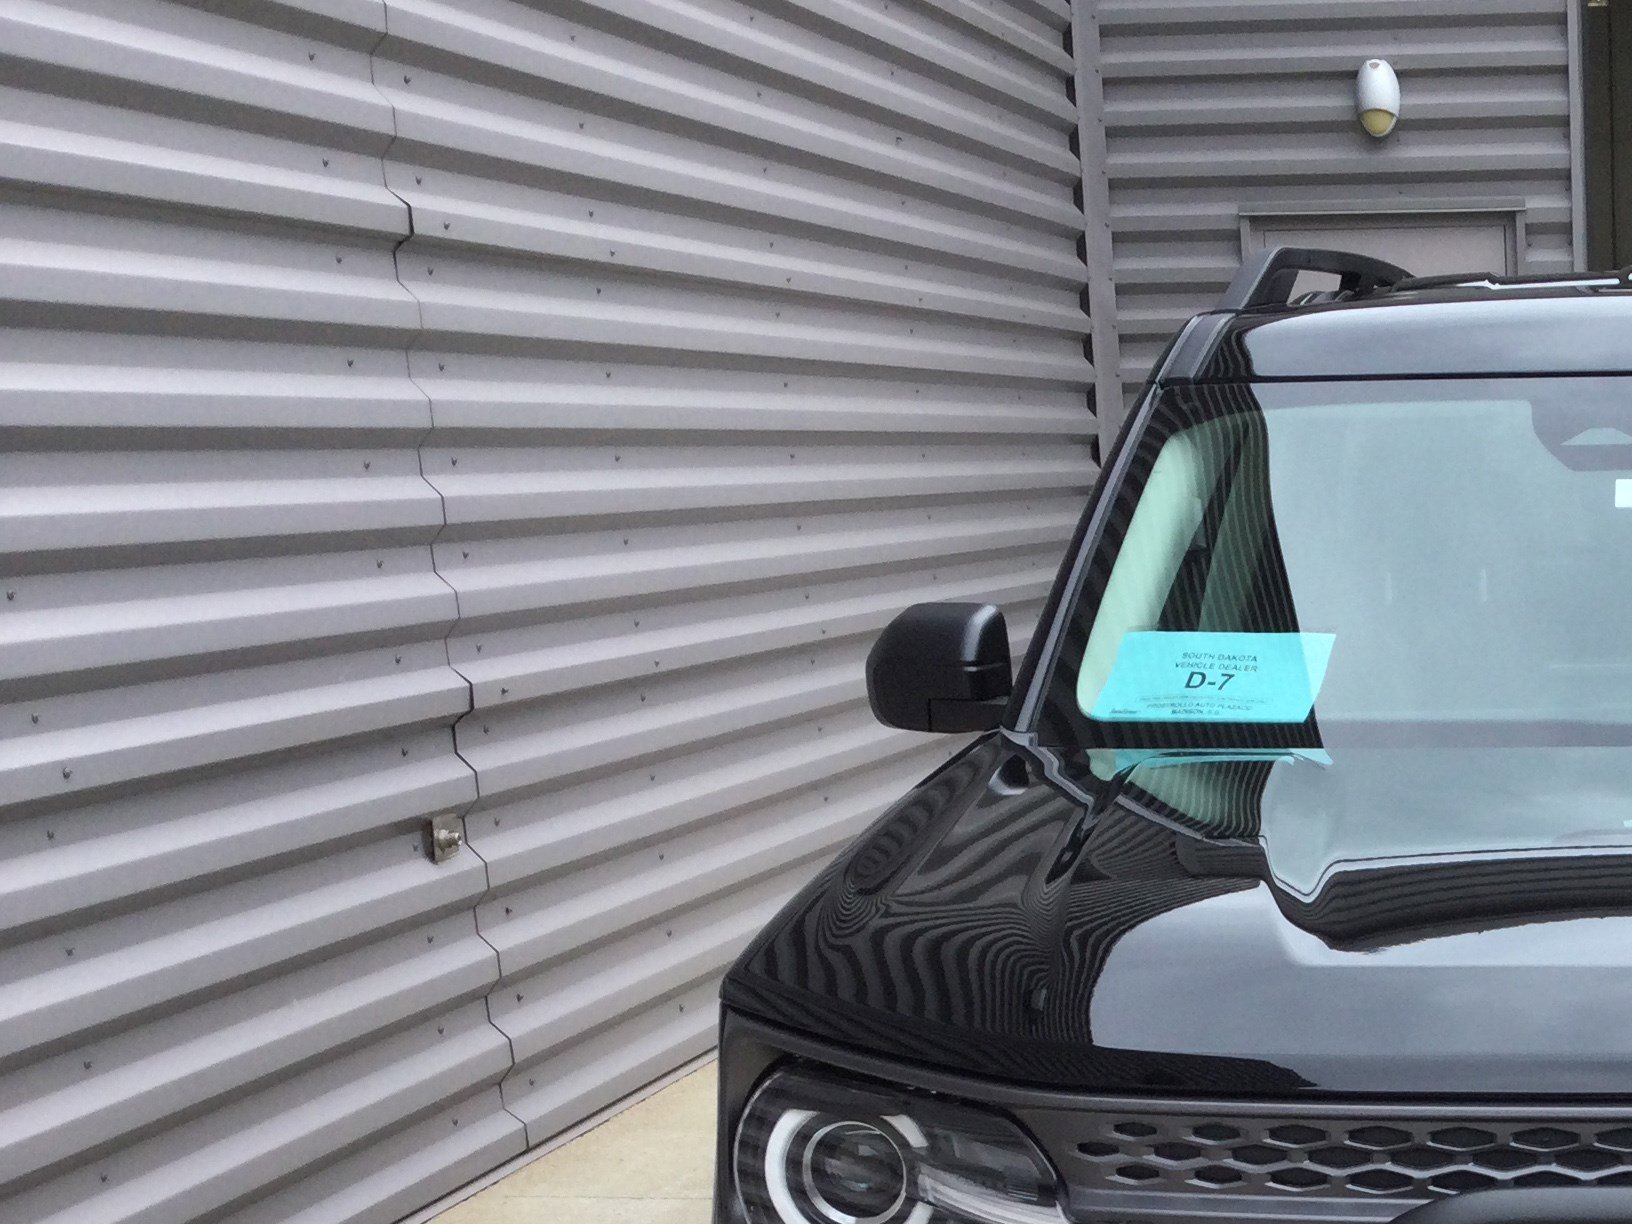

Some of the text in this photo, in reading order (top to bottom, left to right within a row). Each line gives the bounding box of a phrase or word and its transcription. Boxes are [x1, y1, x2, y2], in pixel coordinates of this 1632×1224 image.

[1181, 651, 1258, 662] SOUTH DAKOTA
[1175, 661, 1258, 672] VEHICLE DEALER
[1184, 671, 1236, 691] D-7
